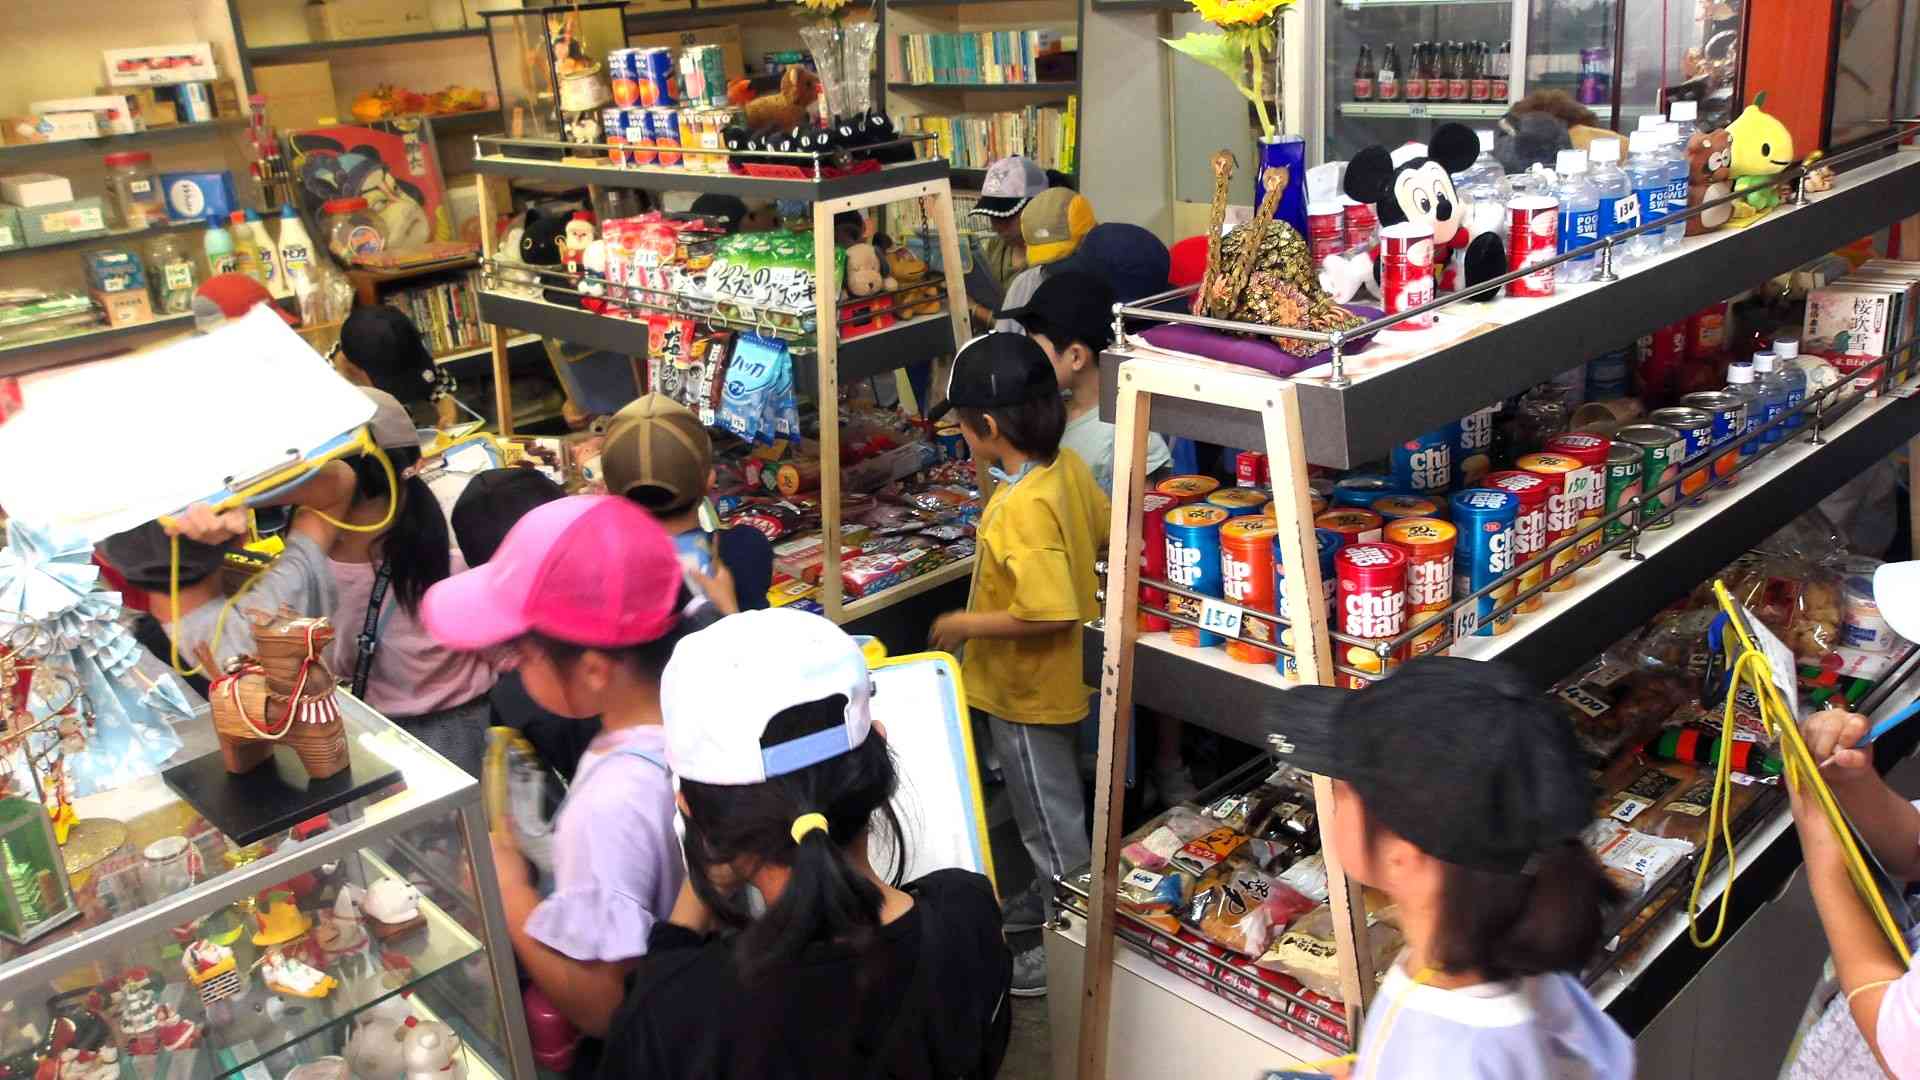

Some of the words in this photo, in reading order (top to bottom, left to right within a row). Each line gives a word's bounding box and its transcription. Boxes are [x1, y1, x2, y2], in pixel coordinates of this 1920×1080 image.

[1620, 201, 1634, 217] 130
[732, 355, 766, 378] ハッカ
[1568, 477, 1588, 494] 150
[1345, 590, 1405, 617] chip
[1204, 607, 1238, 628] 150
[1345, 611, 1405, 638] star
[1456, 612, 1475, 640] 150
